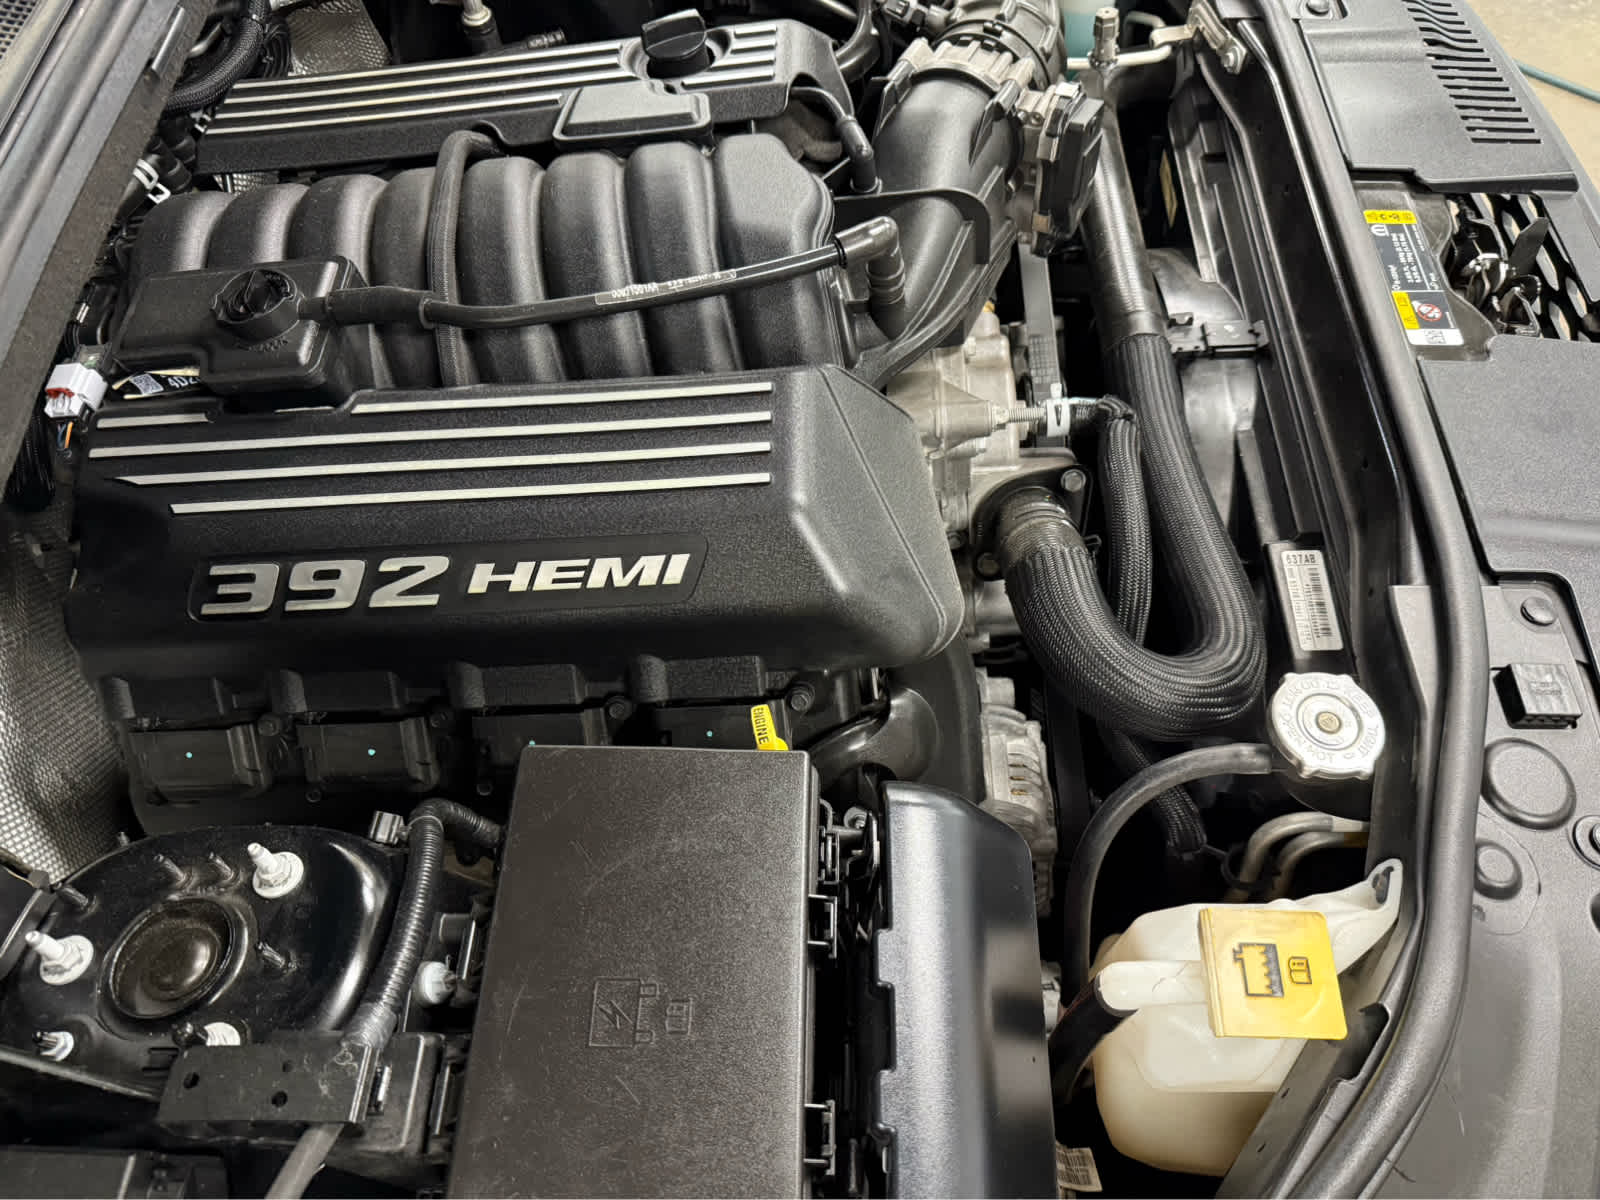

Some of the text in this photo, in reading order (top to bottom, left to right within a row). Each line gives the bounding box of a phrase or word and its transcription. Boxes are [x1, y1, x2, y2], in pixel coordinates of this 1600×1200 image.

[200, 553, 691, 615] 392 HEMI
[753, 706, 770, 745] ENGINE
